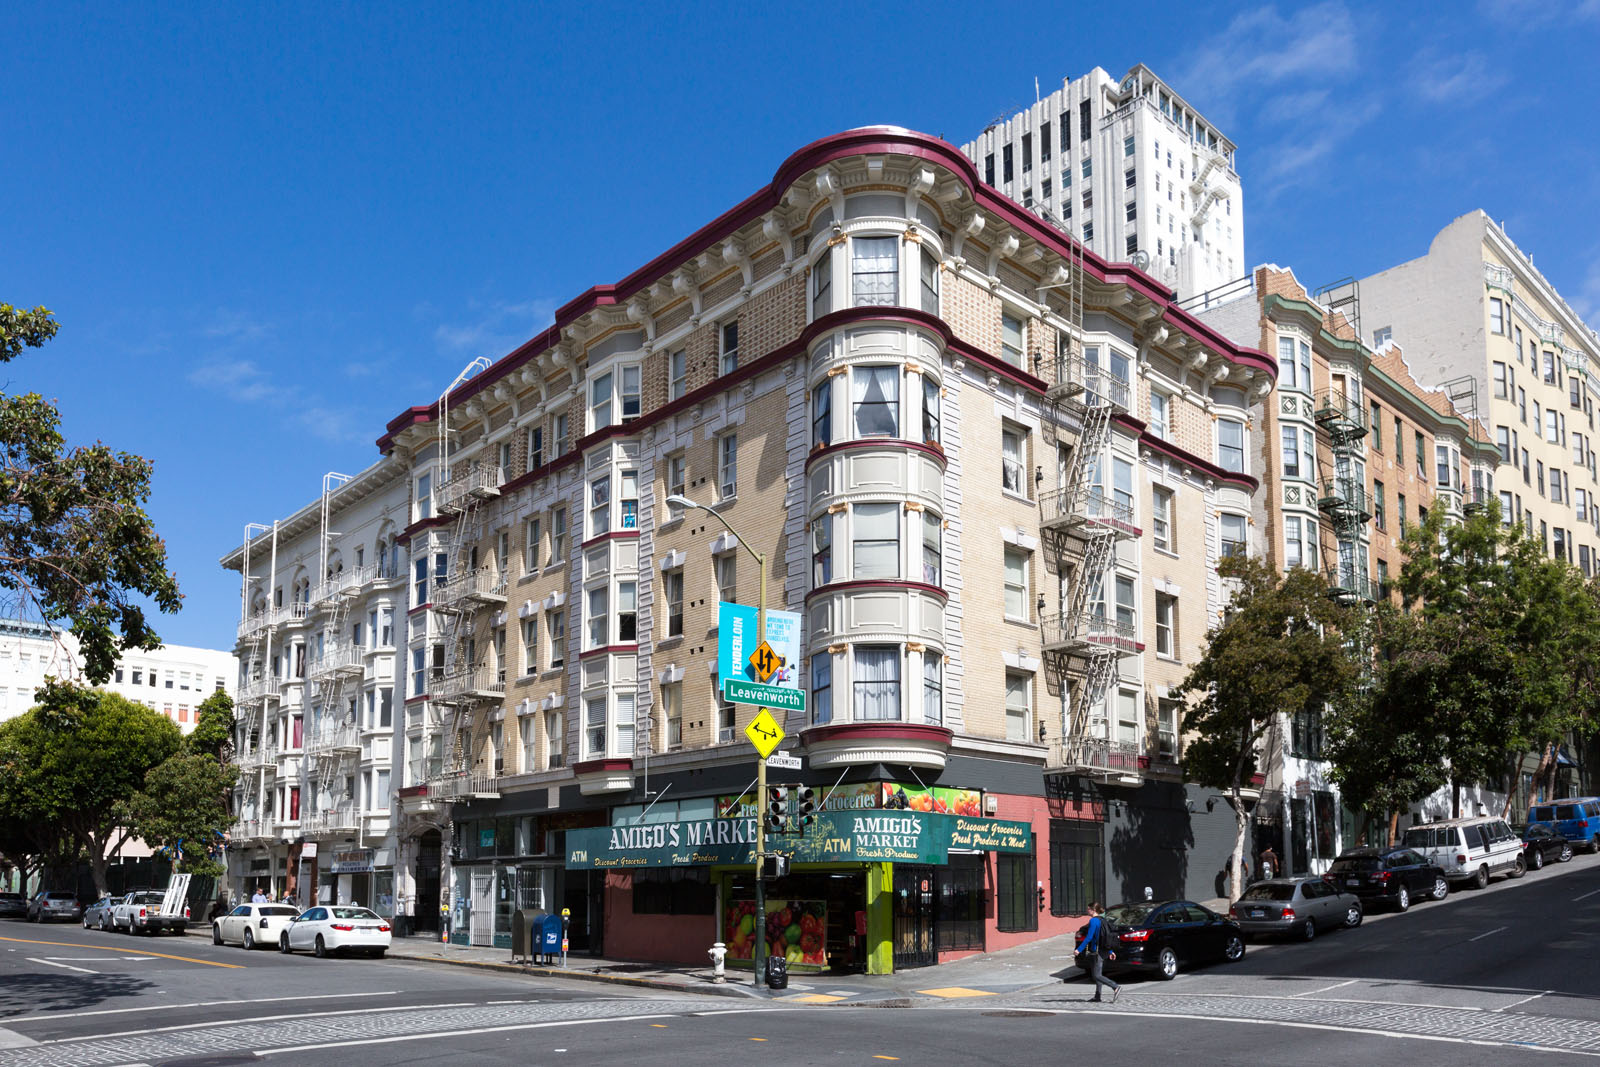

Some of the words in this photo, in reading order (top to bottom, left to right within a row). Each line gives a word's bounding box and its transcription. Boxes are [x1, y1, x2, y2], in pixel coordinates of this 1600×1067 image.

[732, 616, 743, 676] TENDERLOIN
[730, 684, 800, 706] Leavenworth
[825, 792, 876, 810] Groceries
[852, 815, 922, 835] AMIGO'S
[956, 819, 989, 833] Discount
[990, 822, 1023, 836] Groceries
[609, 822, 680, 850] AMIGO'S
[687, 818, 770, 846] MARKE
[856, 834, 918, 849] MARKET
[951, 832, 971, 847] Fresh
[973, 832, 1000, 847] Produce
[1000, 836, 1007, 847] &
[1008, 836, 1027, 848] Meat
[823, 837, 851, 853] ATM
[571, 850, 588, 863] ATM
[671, 853, 690, 864] Fresh
[691, 852, 718, 864] Produce
[856, 847, 884, 858] Fresh
[884, 848, 920, 860] Produce
[594, 857, 619, 867] Discount
[620, 856, 648, 868] Groceries
